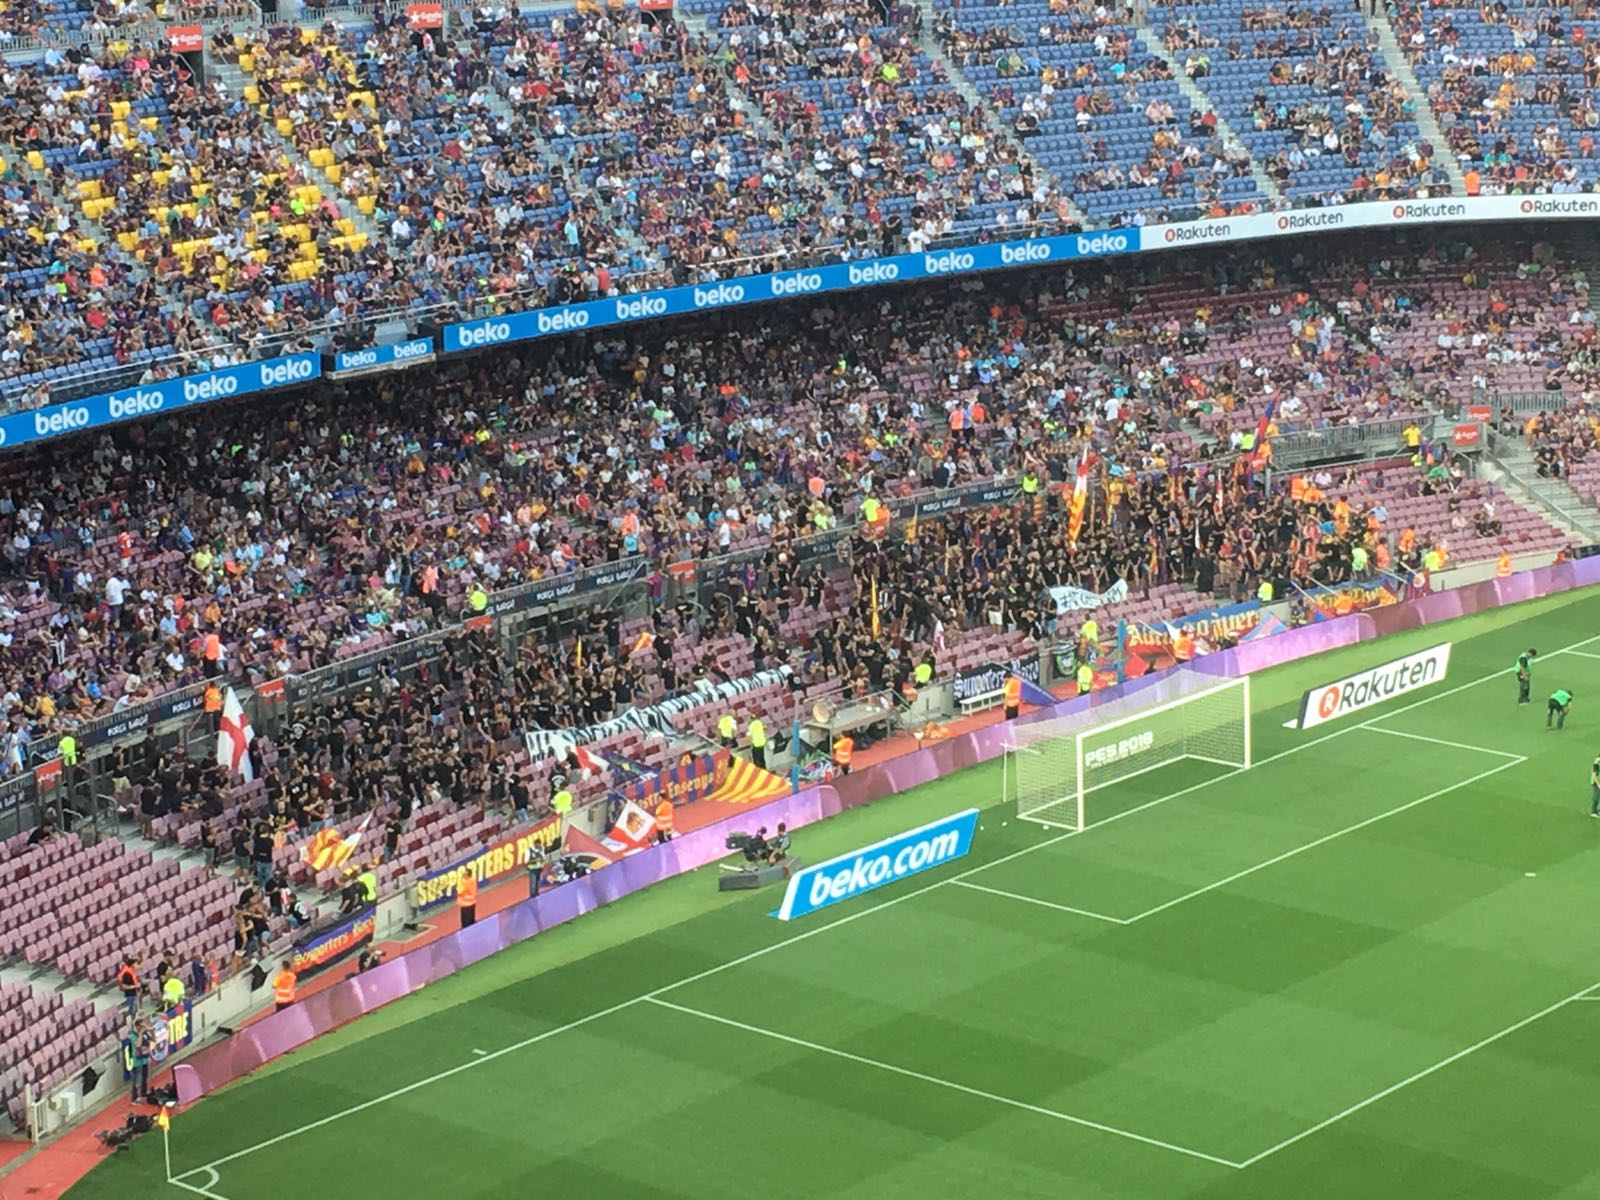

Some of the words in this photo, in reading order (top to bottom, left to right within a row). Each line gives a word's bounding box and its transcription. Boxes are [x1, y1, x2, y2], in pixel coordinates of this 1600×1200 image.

[1406, 202, 1465, 218] Rakuten
[1534, 198, 1598, 214] Rakuten
[1176, 221, 1231, 241] Rakuten
[1289, 211, 1343, 230] Rakuten
[1001, 242, 1050, 264] beko
[1077, 232, 1127, 254] beko
[849, 262, 899, 285] beko
[925, 252, 974, 274] beko
[694, 282, 744, 307] beko
[771, 271, 822, 295] beko
[616, 295, 667, 320] beko
[538, 308, 589, 333] beko
[459, 321, 511, 346] beko
[342, 350, 377, 368] beko
[393, 341, 427, 359] beko
[260, 356, 313, 386] beko
[183, 372, 238, 402] beko
[108, 387, 164, 419] beko
[35, 405, 89, 436] beko
[1339, 656, 1437, 712] Rakuten
[809, 829, 960, 906] beko.com
